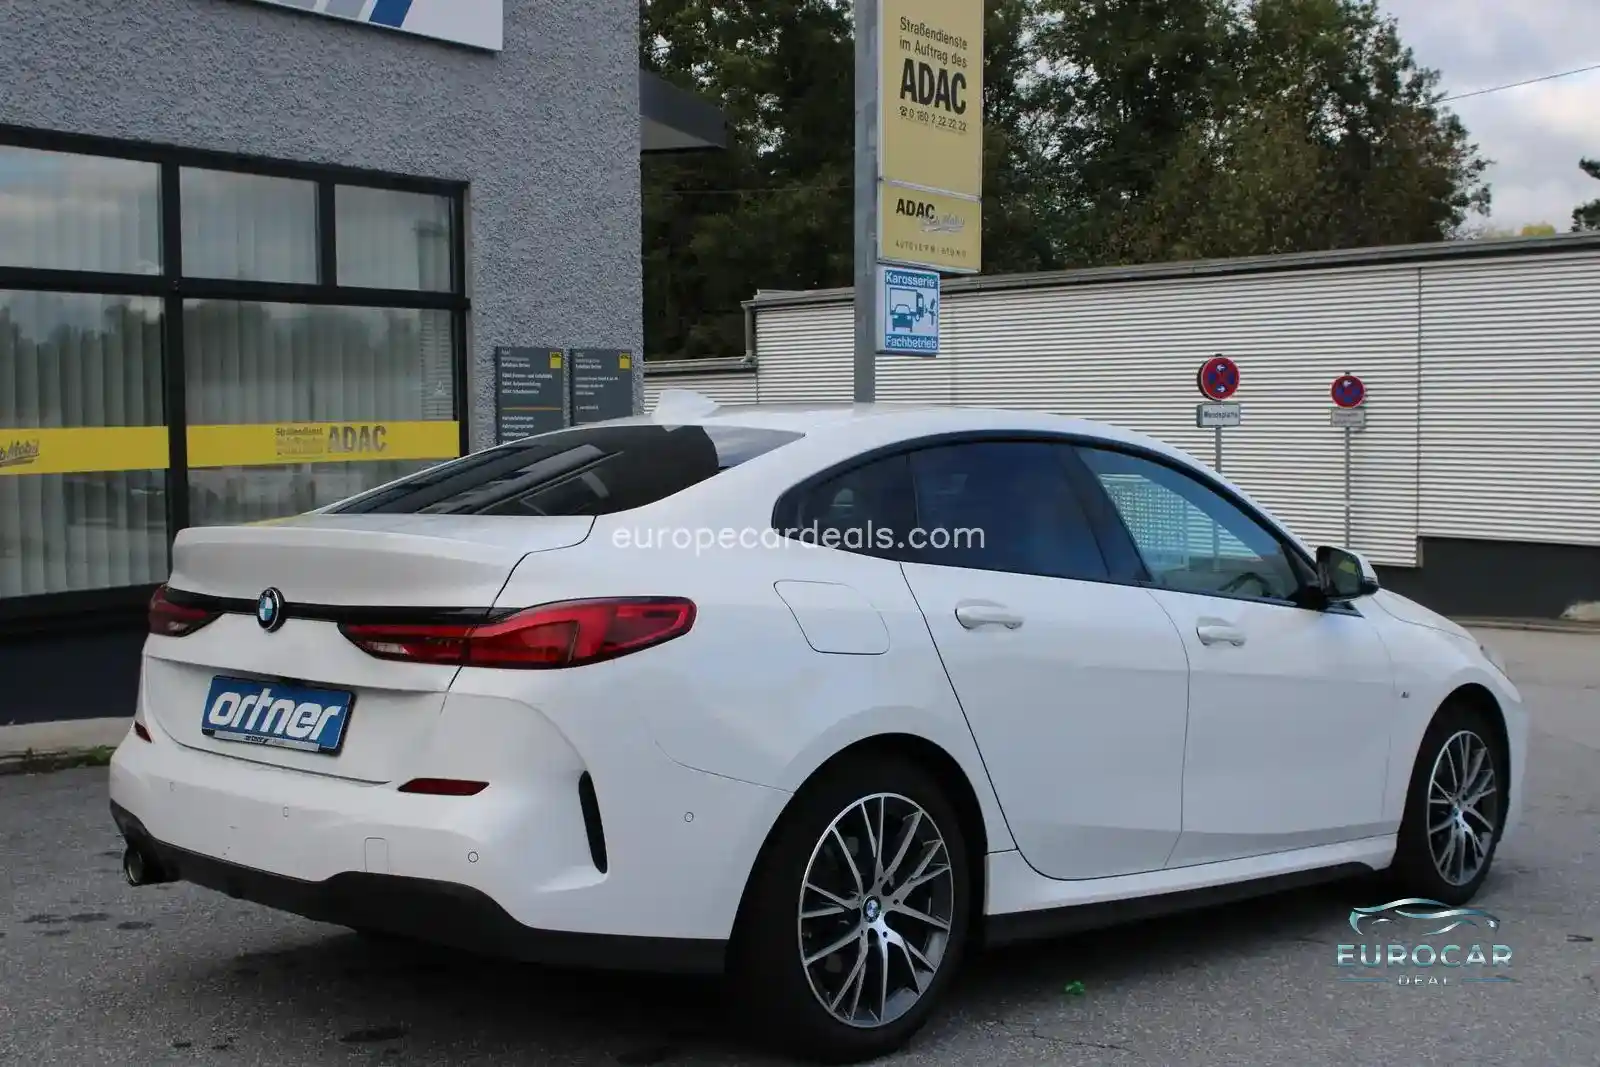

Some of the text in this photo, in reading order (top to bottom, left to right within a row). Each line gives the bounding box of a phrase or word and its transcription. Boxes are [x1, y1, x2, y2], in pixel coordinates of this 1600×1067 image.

[900, 15, 968, 51] Straßendienste
[899, 37, 968, 68] im Auftrag des
[900, 58, 967, 115] ADAC
[896, 198, 935, 220] ADAC
[886, 271, 935, 287] Karosserie
[886, 336, 937, 349] Fachbetrieb
[327, 424, 388, 455] ADAC
[208, 687, 342, 741] ortner
